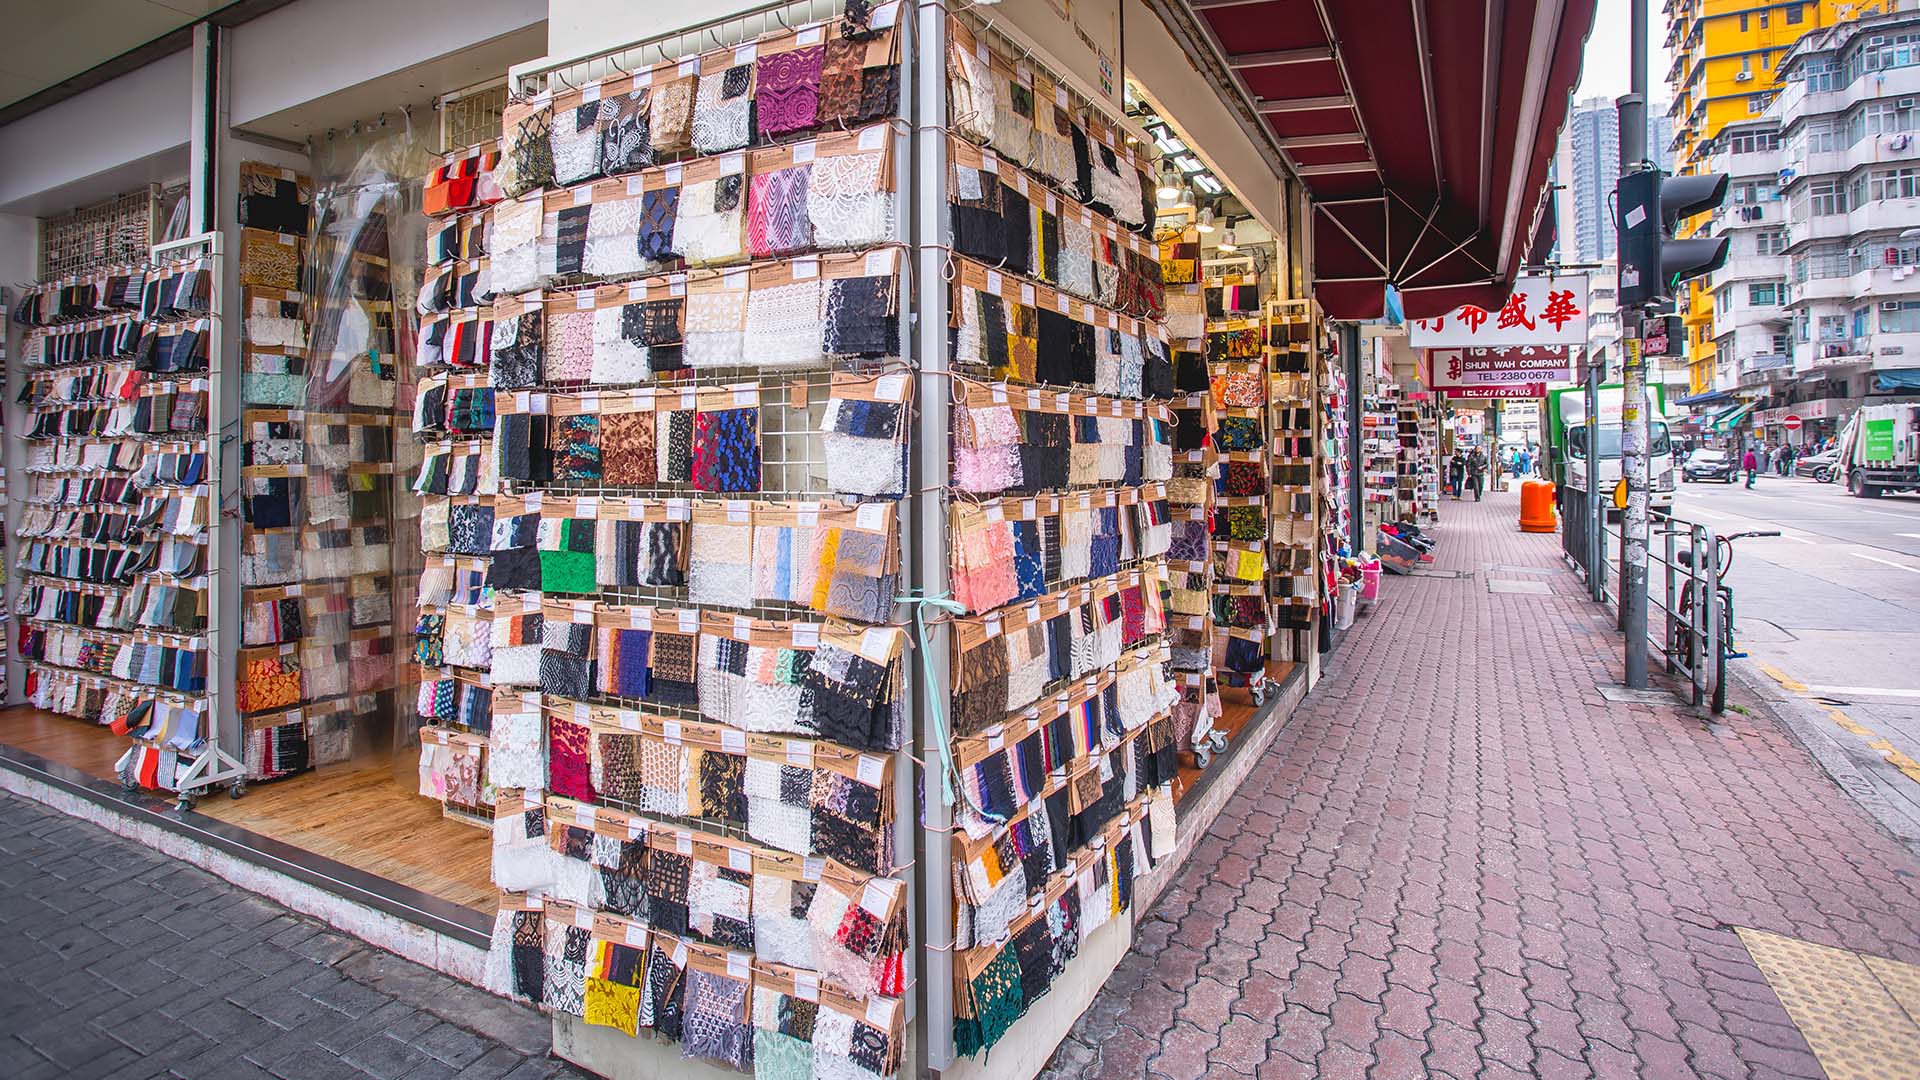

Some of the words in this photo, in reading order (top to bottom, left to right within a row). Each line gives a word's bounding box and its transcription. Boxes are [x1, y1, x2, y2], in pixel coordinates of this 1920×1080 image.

[1465, 361, 1490, 370] SHUN
[1494, 360, 1516, 369] WAH
[1520, 359, 1566, 368] COMPANY
